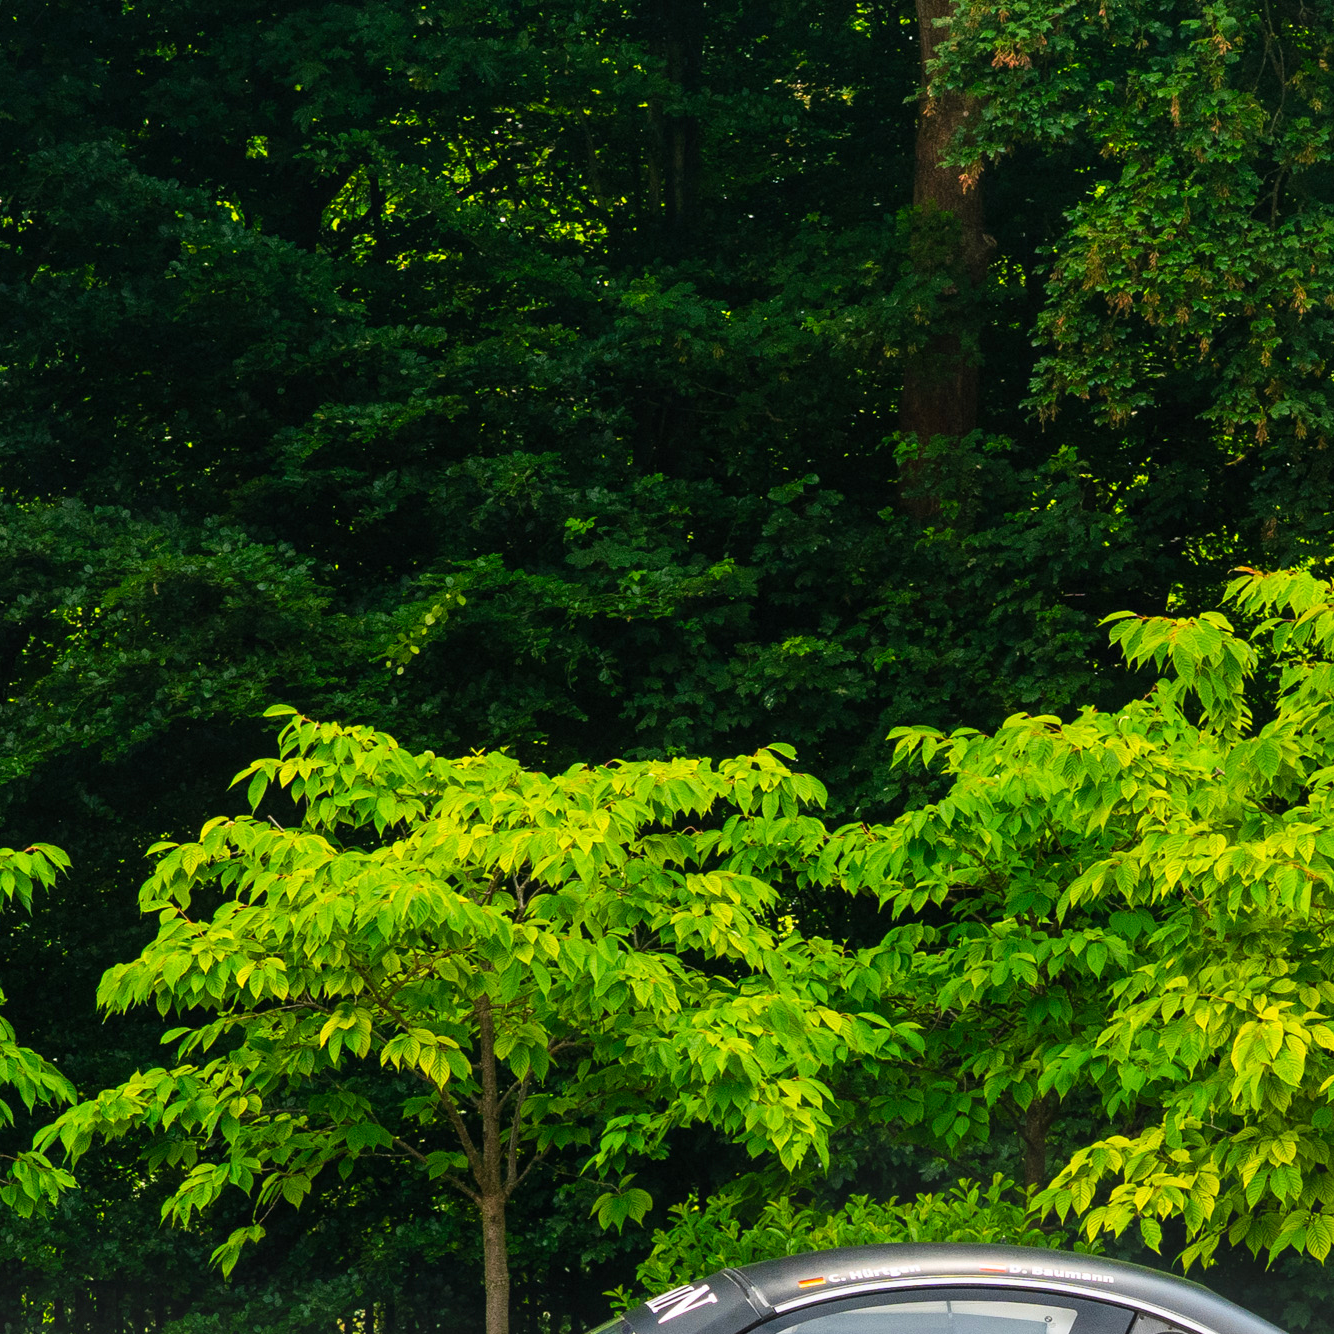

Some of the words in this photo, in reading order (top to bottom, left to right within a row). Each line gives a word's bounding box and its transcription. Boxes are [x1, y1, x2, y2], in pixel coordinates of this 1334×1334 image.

[828, 1273, 847, 1283] C.
[1009, 1264, 1028, 1275] D.
[1031, 1266, 1115, 1284] Baumann
